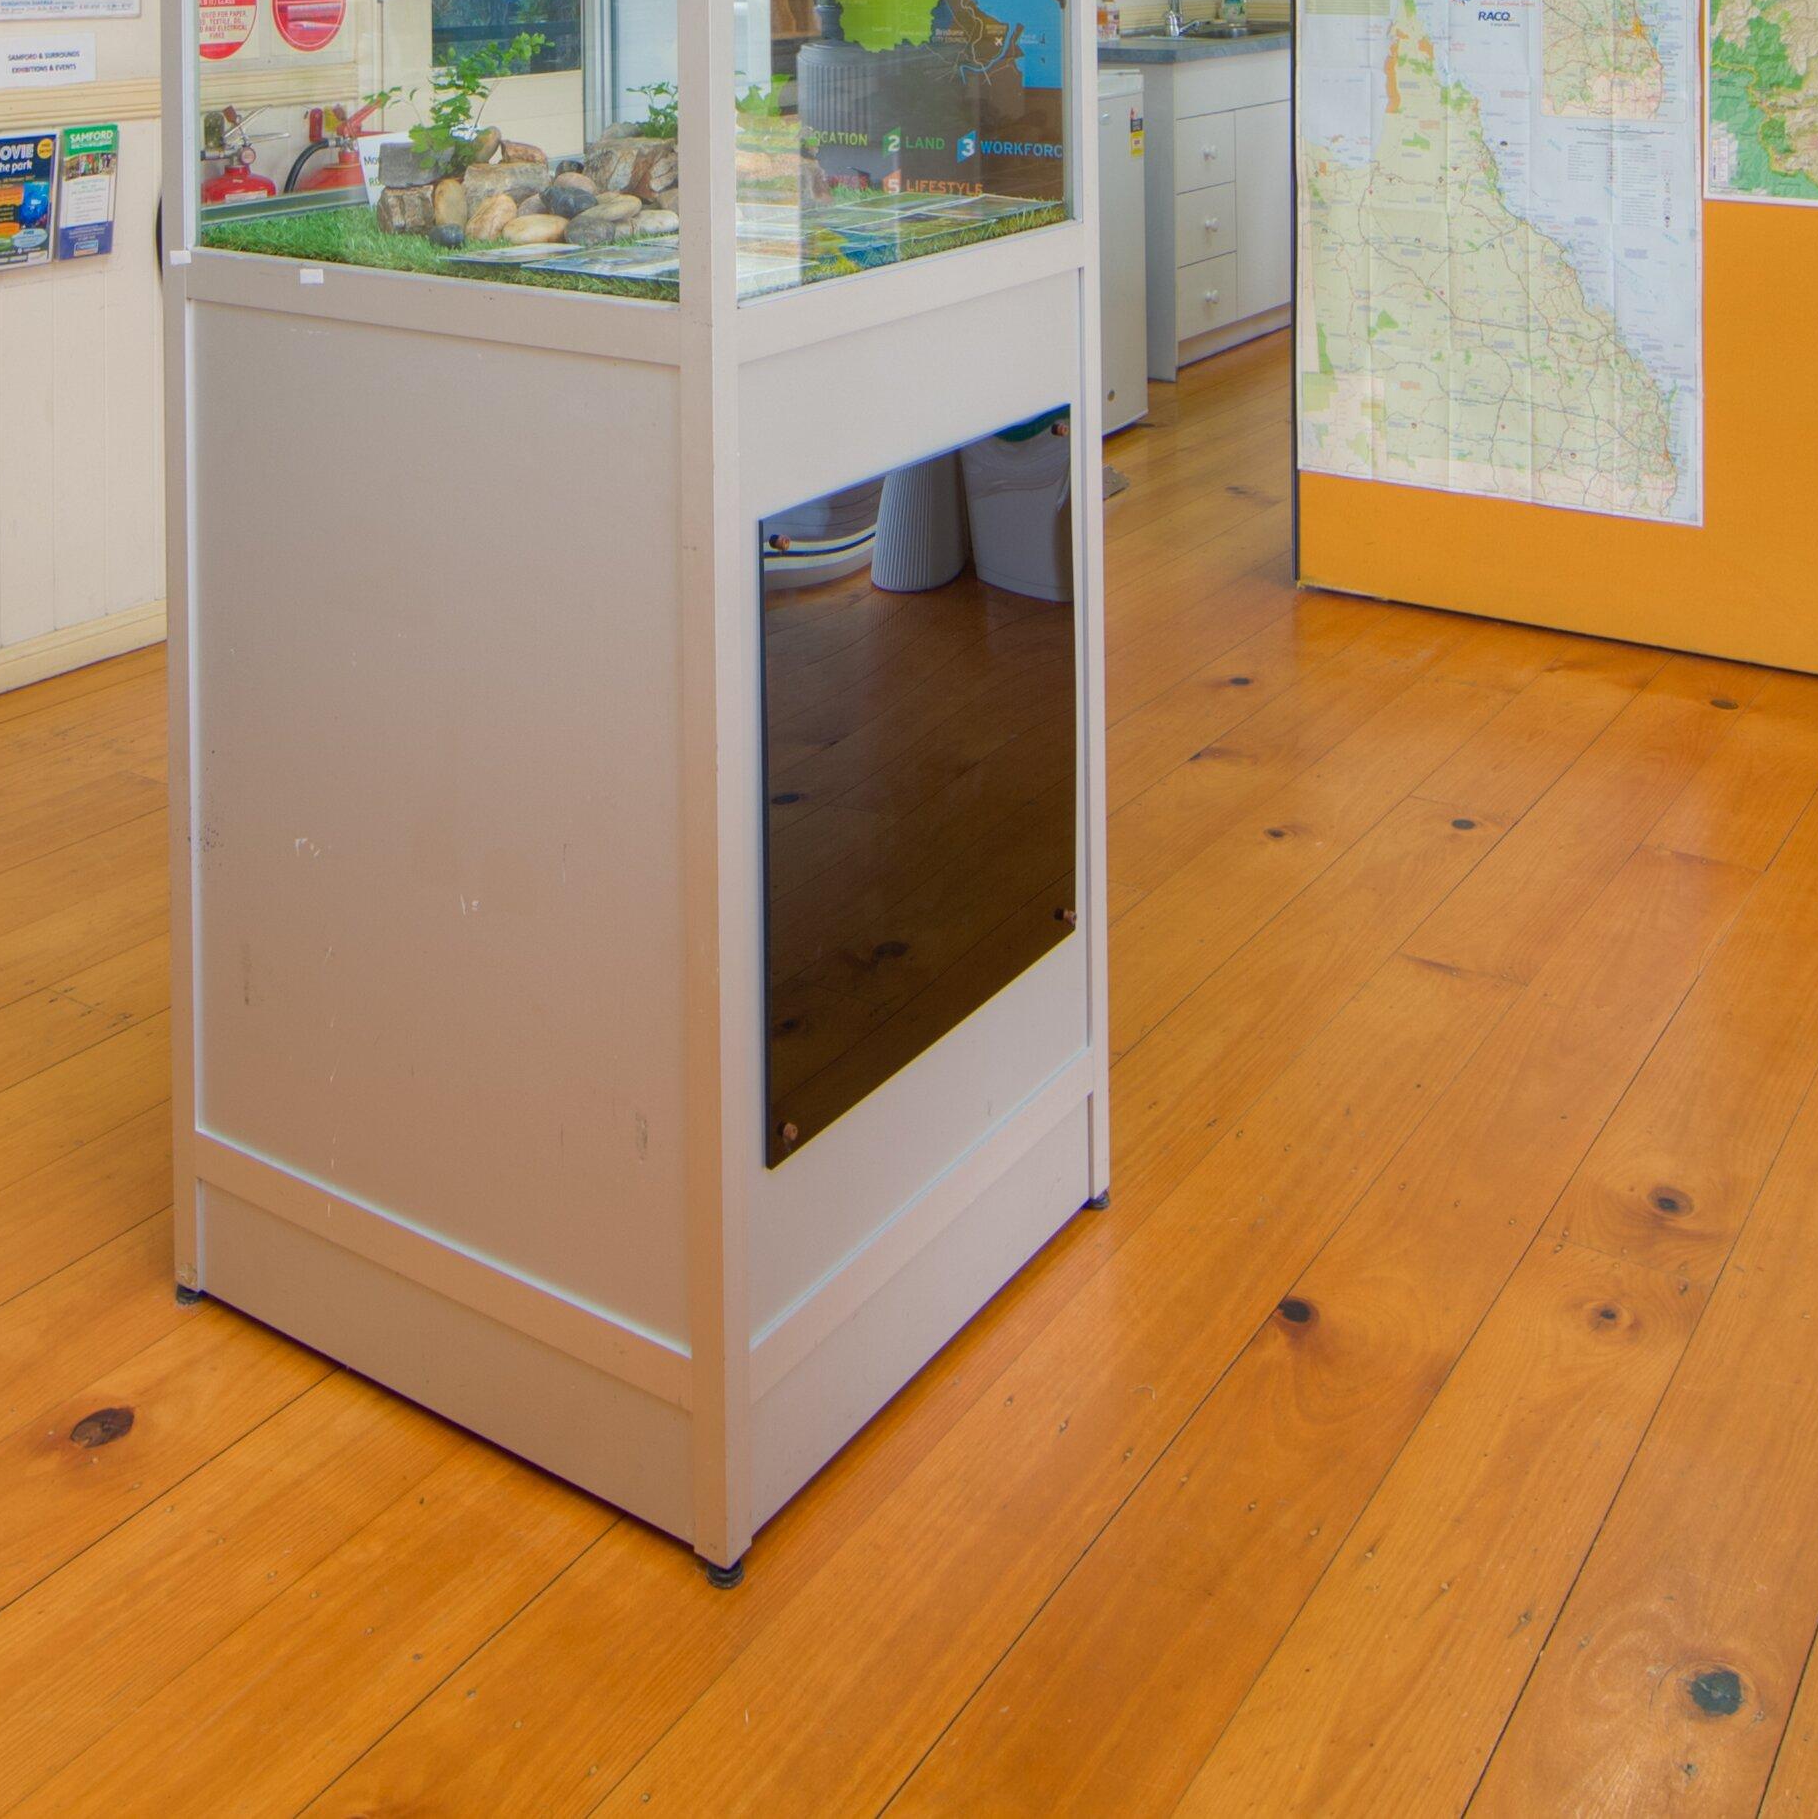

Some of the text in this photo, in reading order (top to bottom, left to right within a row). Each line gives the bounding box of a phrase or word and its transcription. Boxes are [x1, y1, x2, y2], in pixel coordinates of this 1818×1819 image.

[1478, 11, 1511, 21] RACQ
[8, 53, 37, 62] SAMFORD
[45, 50, 80, 59] SURROUNDS
[11, 64, 46, 74] EXHIBITIONS
[55, 63, 77, 71] EVENTS
[69, 129, 114, 144] SAMFORD
[887, 135, 945, 153] 2 LAND
[961, 138, 1063, 158] 3 WORKFORC
[11, 160, 33, 175] park
[887, 178, 983, 197] 5 LIFESTYLE
